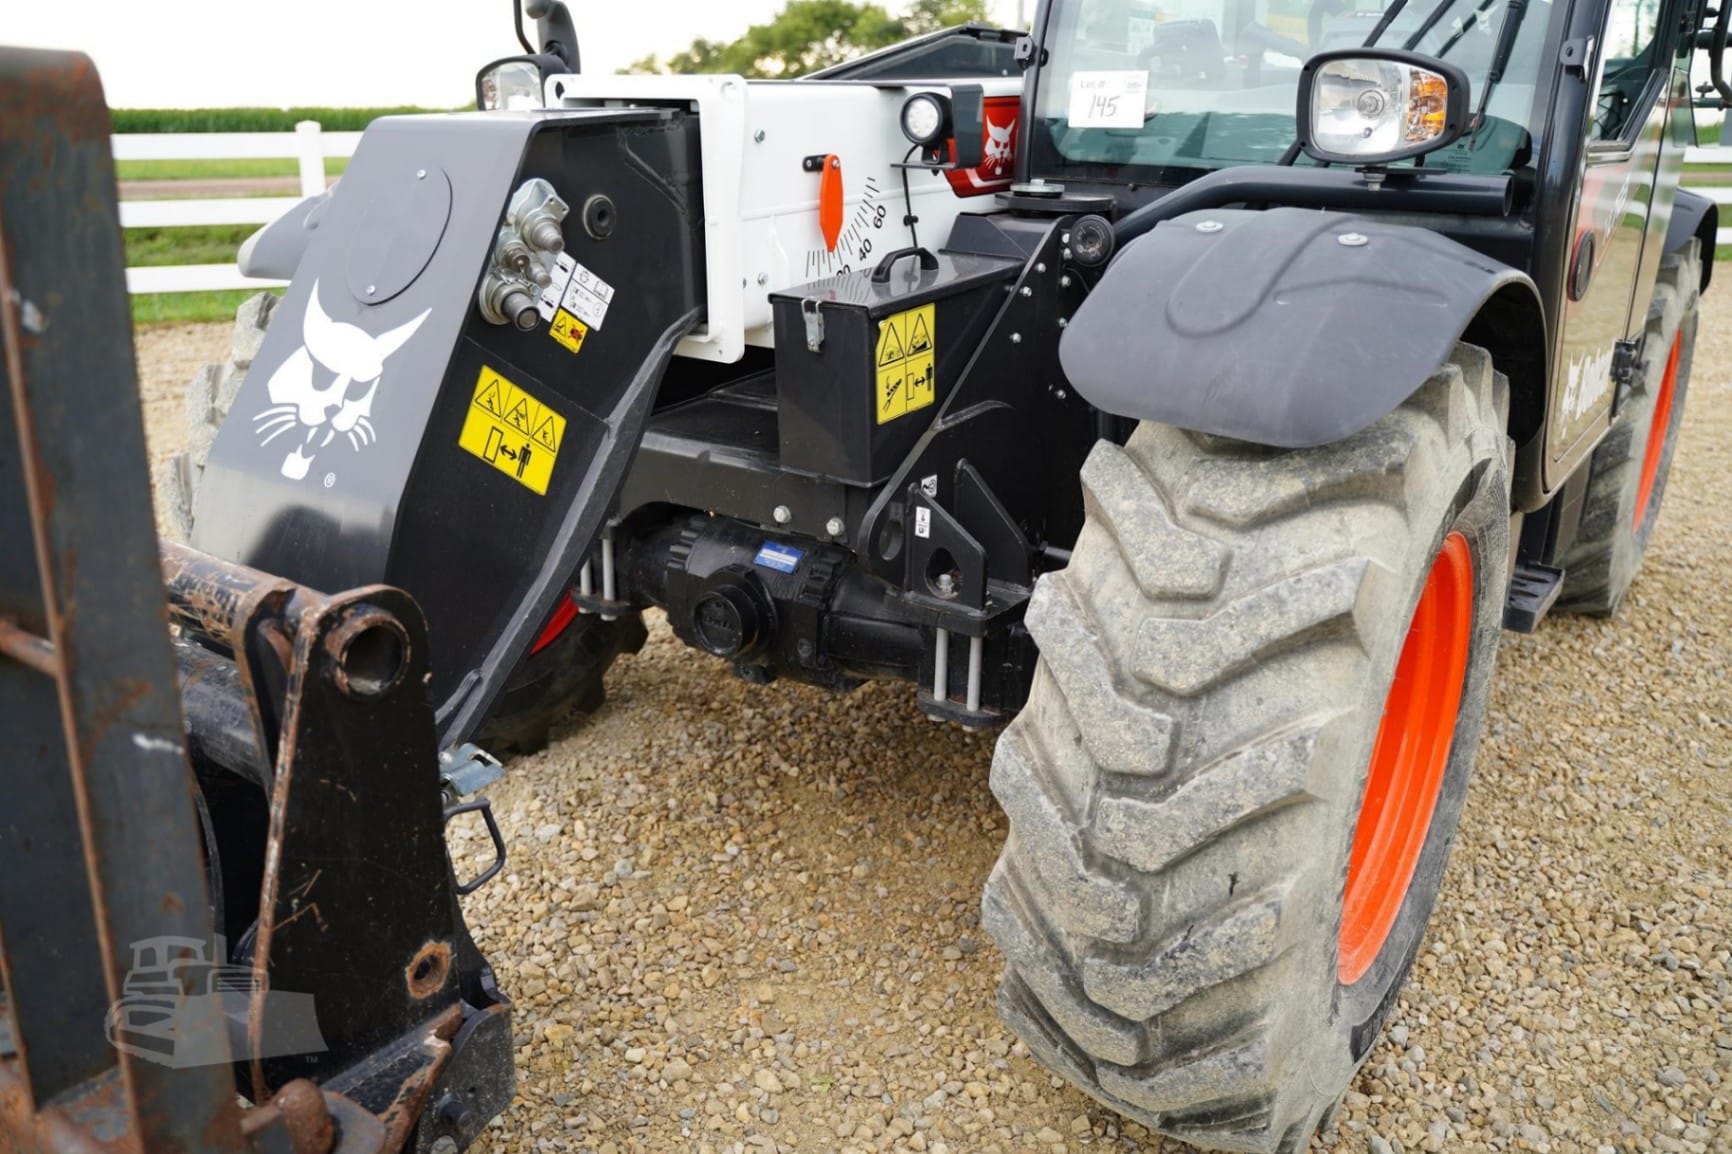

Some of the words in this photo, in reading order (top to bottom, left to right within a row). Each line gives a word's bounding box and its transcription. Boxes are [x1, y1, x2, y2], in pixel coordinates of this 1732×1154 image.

[1080, 80, 1095, 89] Lot
[1088, 93, 1120, 119] 145
[873, 205, 886, 229] 60
[859, 239, 872, 261] 40
